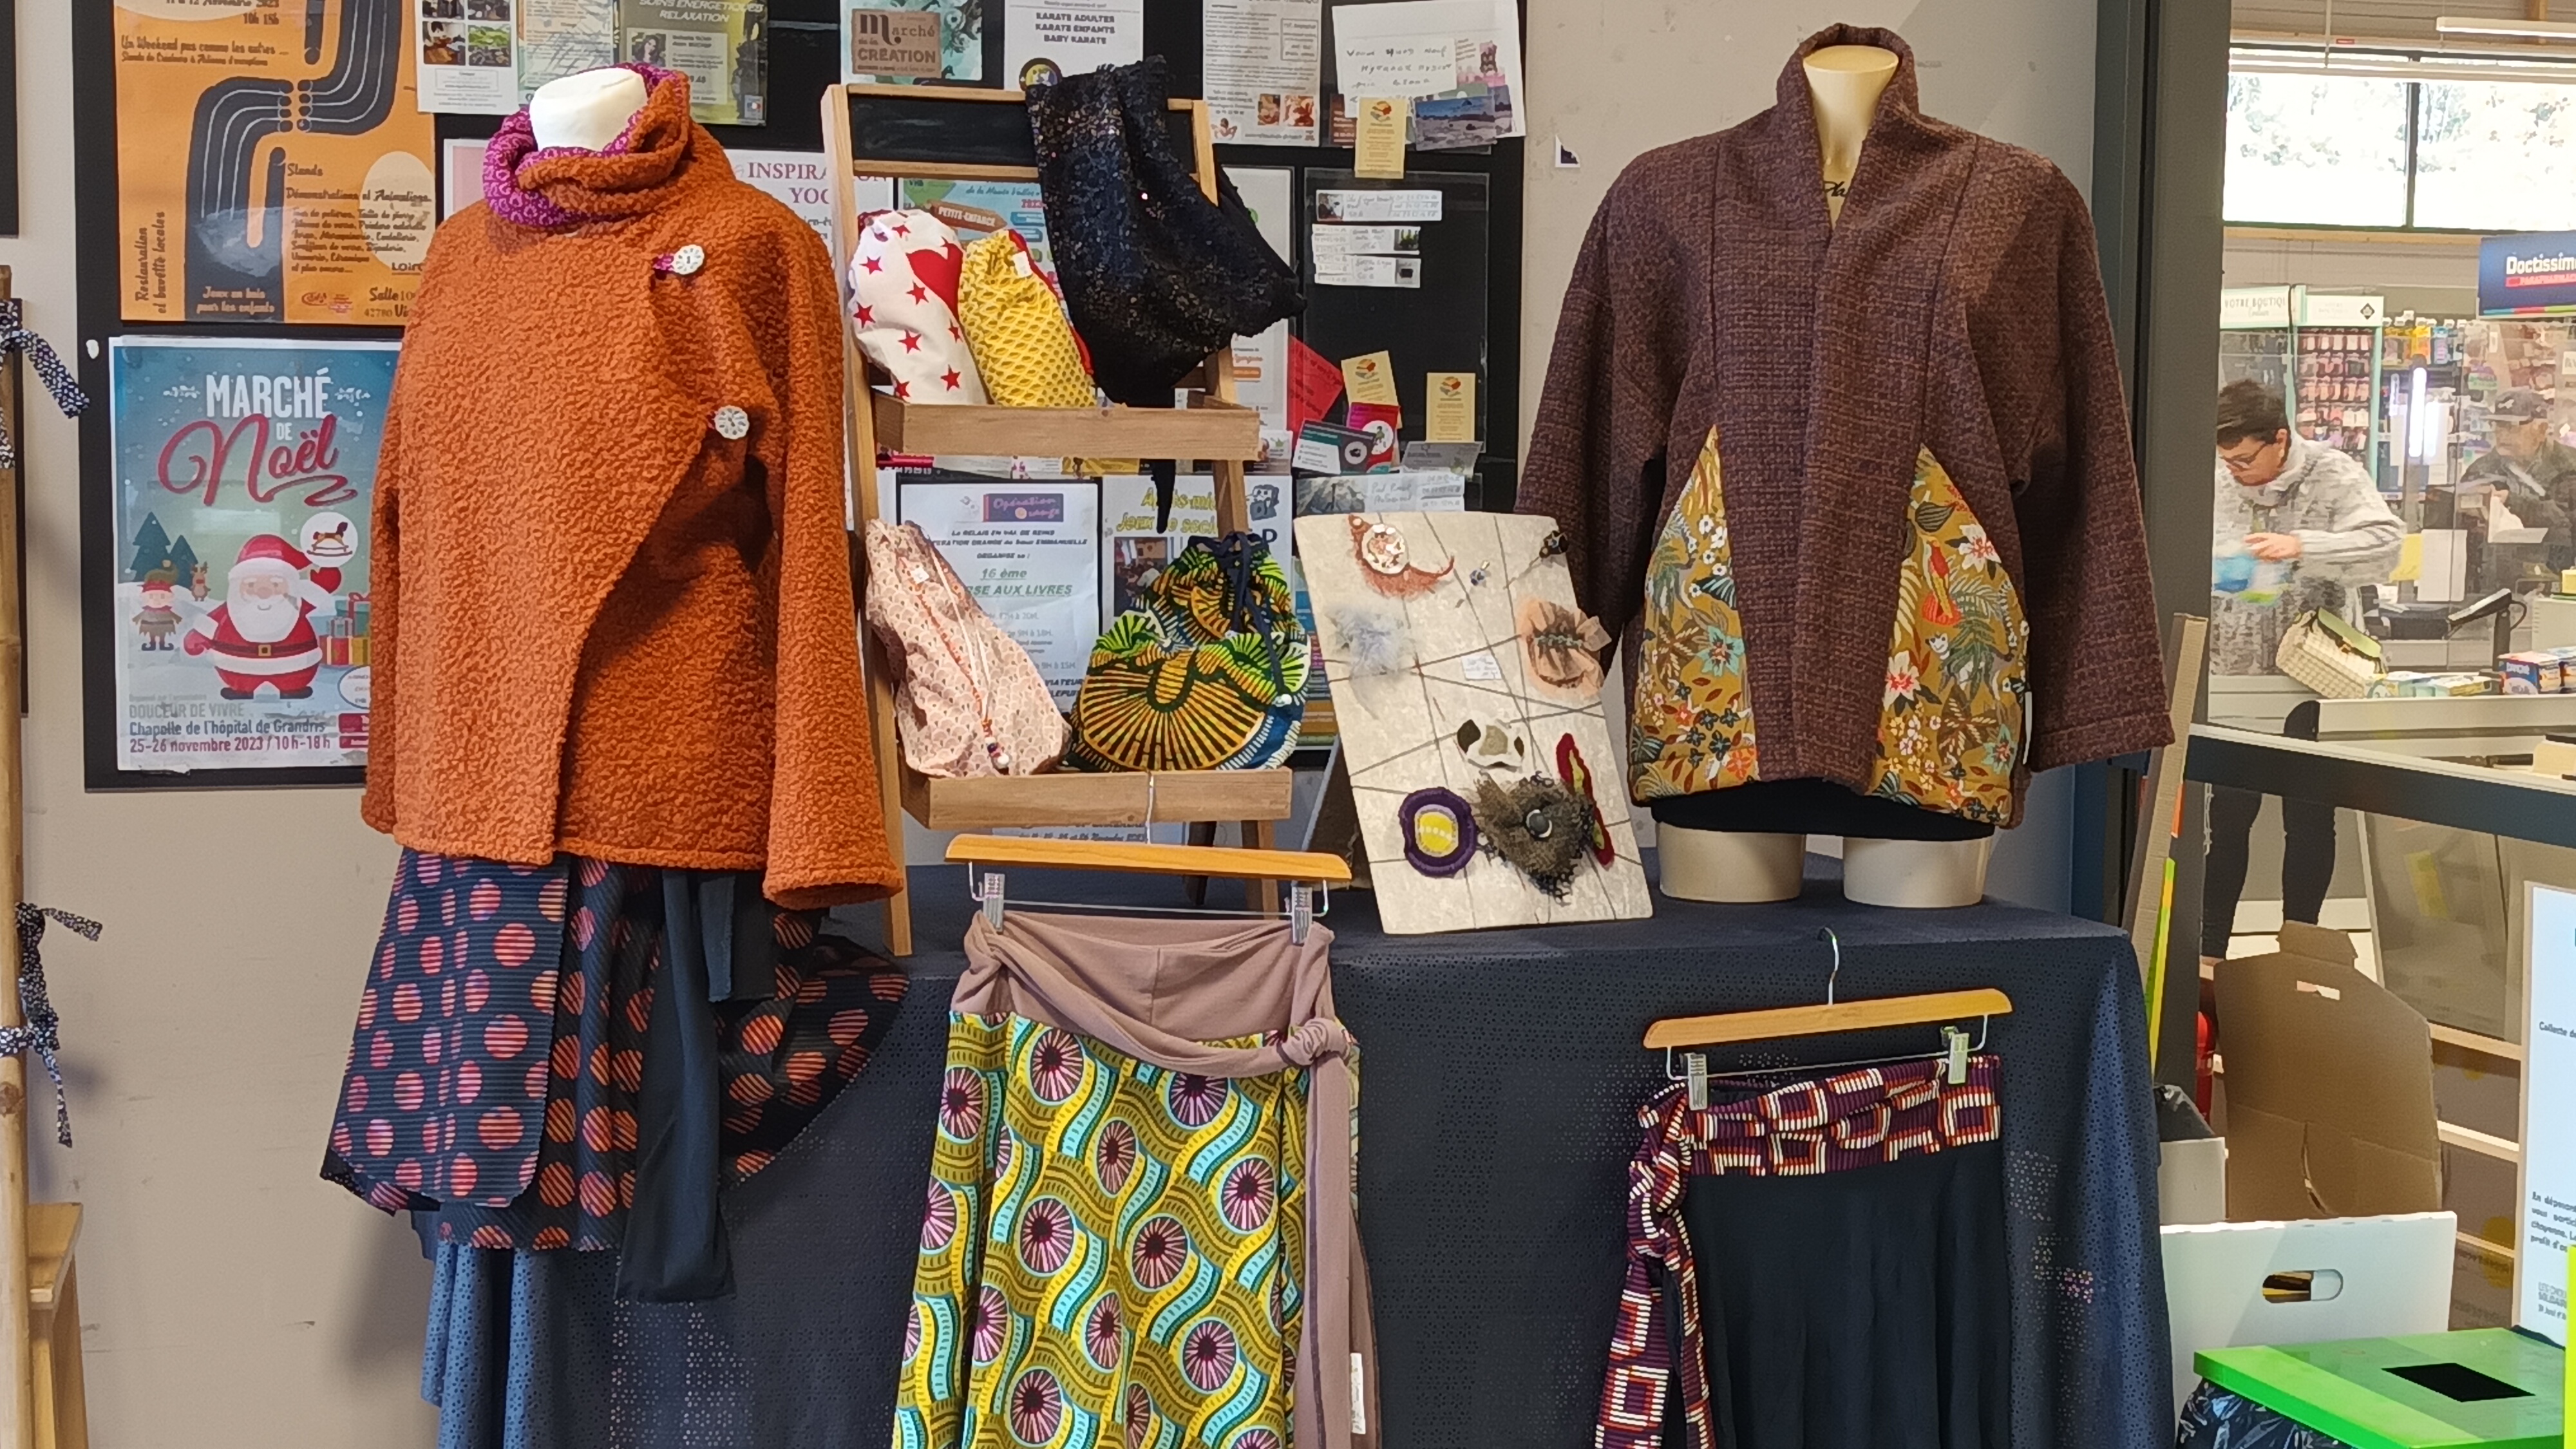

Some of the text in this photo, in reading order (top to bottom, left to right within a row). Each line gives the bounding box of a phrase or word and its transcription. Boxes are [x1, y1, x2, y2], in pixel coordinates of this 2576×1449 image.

[659, 10, 730, 23] RELAXATION
[287, 163, 323, 176] Stands
[2506, 252, 2576, 274] Doctissim
[369, 287, 399, 301] Salle
[205, 366, 333, 419] MARCHÉ
[276, 422, 293, 440] DE
[158, 413, 345, 507] Noël
[982, 568, 1027, 578] 16 ème
[993, 585, 1023, 595] AUX
[1025, 584, 1073, 594] LIVRES
[129, 703, 245, 719] DOUCEUR DE VIVRE
[129, 721, 182, 737] Chapelle
[185, 721, 200, 734] de
[256, 720, 269, 733] de
[129, 738, 166, 753] 25-26
[170, 738, 231, 752] novembre
[234, 736, 263, 750] 2023
